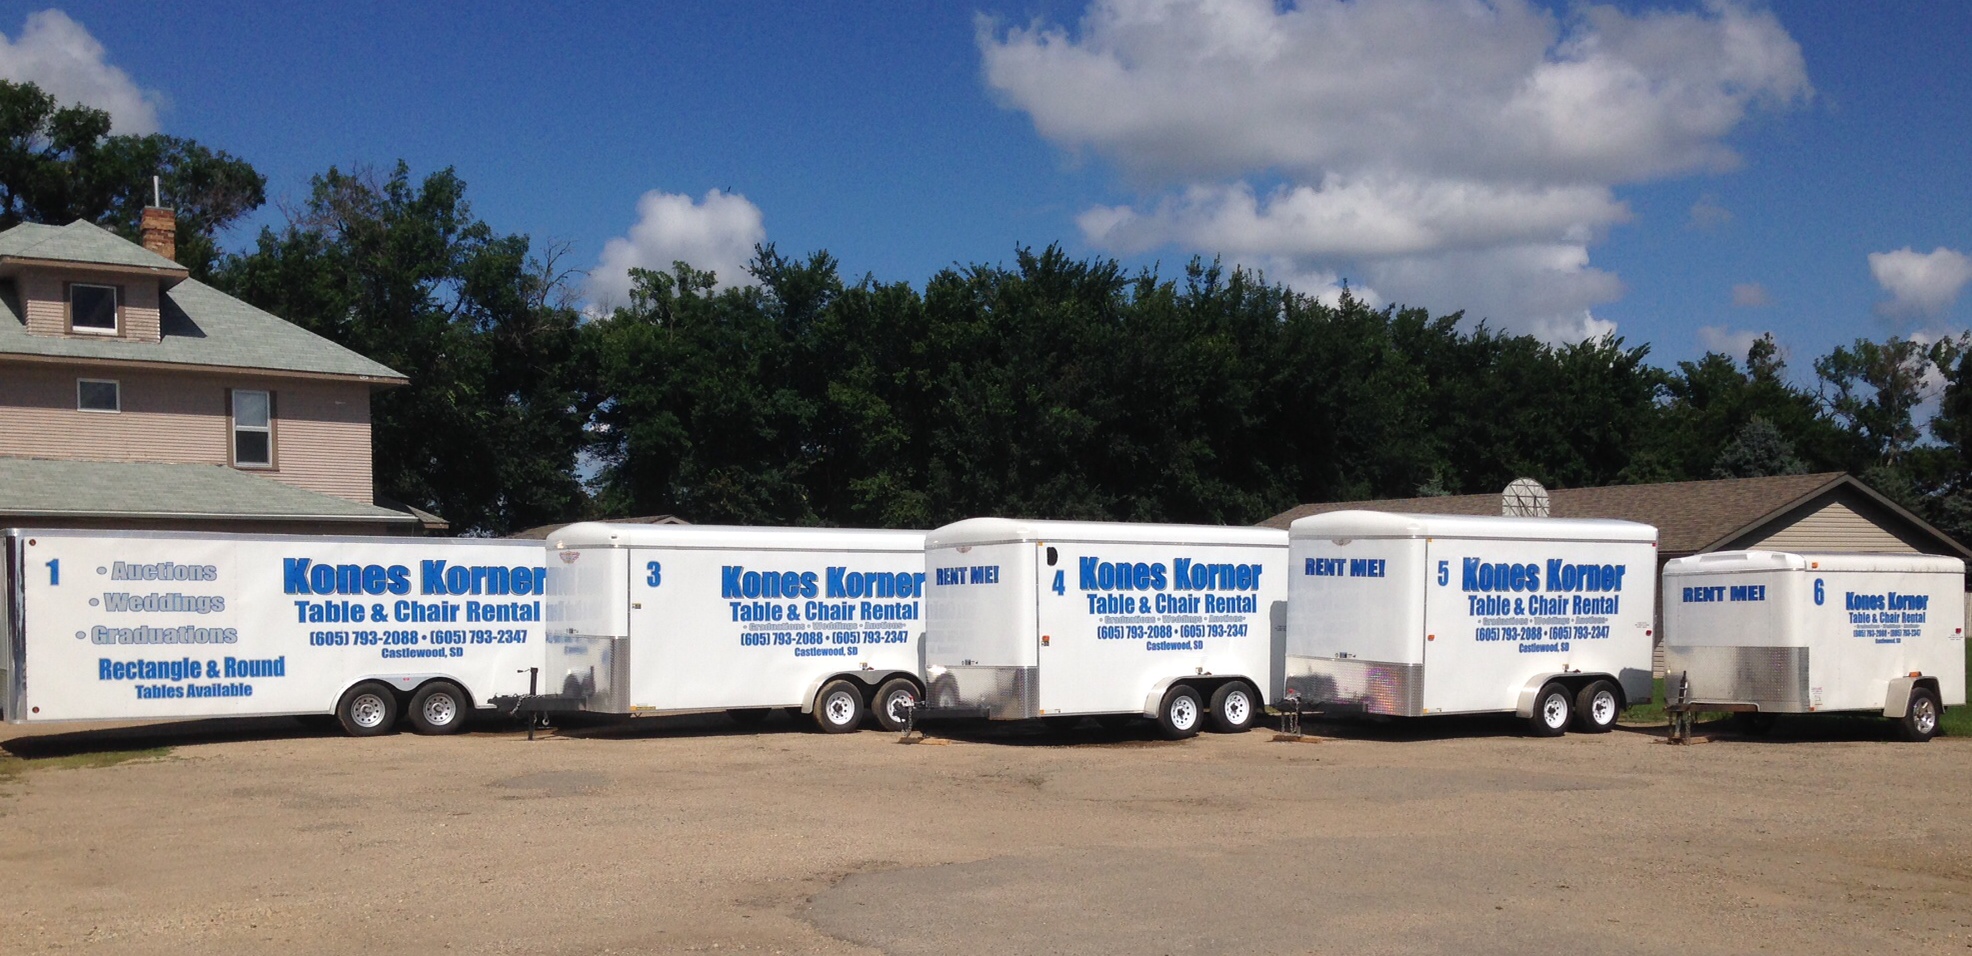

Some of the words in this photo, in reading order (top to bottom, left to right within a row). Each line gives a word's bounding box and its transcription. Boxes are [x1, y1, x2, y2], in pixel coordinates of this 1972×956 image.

[46, 559, 60, 586] 1
[112, 562, 217, 581] Auctions
[284, 558, 410, 595] Kones
[422, 560, 546, 595] Korner
[646, 561, 661, 587] 3
[936, 567, 967, 585] RENT
[970, 566, 999, 584] ME!
[1079, 557, 1167, 591] Kones
[1173, 558, 1262, 591] Korner
[1305, 558, 1347, 576] RENT
[1350, 558, 1386, 578] ME!
[1438, 561, 1449, 587] 5
[1462, 557, 1540, 592] Kones
[1546, 558, 1626, 592] Korner
[721, 566, 818, 599] Kones
[826, 566, 926, 599] Korner
[1052, 569, 1065, 596] 4
[1814, 578, 1824, 605] 6
[104, 593, 225, 613] Weddings
[1087, 594, 1135, 614] Table
[1139, 596, 1151, 613] &
[1155, 593, 1200, 613] Chair
[1205, 594, 1257, 613] Rental
[1683, 586, 1726, 603] RENT
[1730, 585, 1765, 602] ME!
[1846, 592, 1885, 610] Kones
[1888, 592, 1929, 610] Korner
[294, 601, 364, 623] Table
[371, 604, 389, 622] &
[394, 601, 460, 623] Chair
[466, 600, 540, 622] Rental
[730, 602, 783, 622] Table
[787, 603, 800, 621] &
[805, 601, 855, 620] Chair
[860, 601, 918, 620] Rental
[1468, 595, 1510, 616] Table
[1514, 597, 1525, 615] &
[1529, 595, 1569, 615] Chair
[1573, 595, 1619, 615] Rental
[1849, 612, 1870, 623] Table
[1872, 614, 1877, 623] &
[1880, 612, 1900, 623] Chair
[1902, 612, 1926, 623] Rental
[91, 625, 238, 645] Graduations
[310, 631, 349, 646] (605)
[352, 630, 419, 646] 793-2088
[430, 629, 467, 645] (605)
[469, 629, 528, 644] 793-2347
[741, 633, 770, 646] (605)
[773, 632, 823, 645] 793-2088
[832, 631, 860, 644] (605)
[863, 631, 908, 644] 793-2347
[1097, 626, 1124, 640] (605)
[1126, 625, 1172, 639] 793-2088
[1180, 625, 1205, 638] (605)
[1207, 624, 1248, 637] 793-2347
[1476, 628, 1499, 641] (605)
[1501, 627, 1542, 641] 793-2088
[1549, 626, 1572, 640] (605)
[1574, 626, 1610, 639] 793-2347
[381, 647, 447, 659] Castlewood,
[449, 646, 463, 657] SD
[794, 647, 845, 657] Castlewood,
[847, 647, 858, 655] SD
[1193, 640, 1203, 650] SD
[1561, 642, 1569, 652] SD
[99, 658, 202, 681] Rectangle
[207, 658, 221, 678] &
[224, 656, 285, 678] Round
[135, 683, 185, 699] Tables
[187, 681, 253, 699] Available
